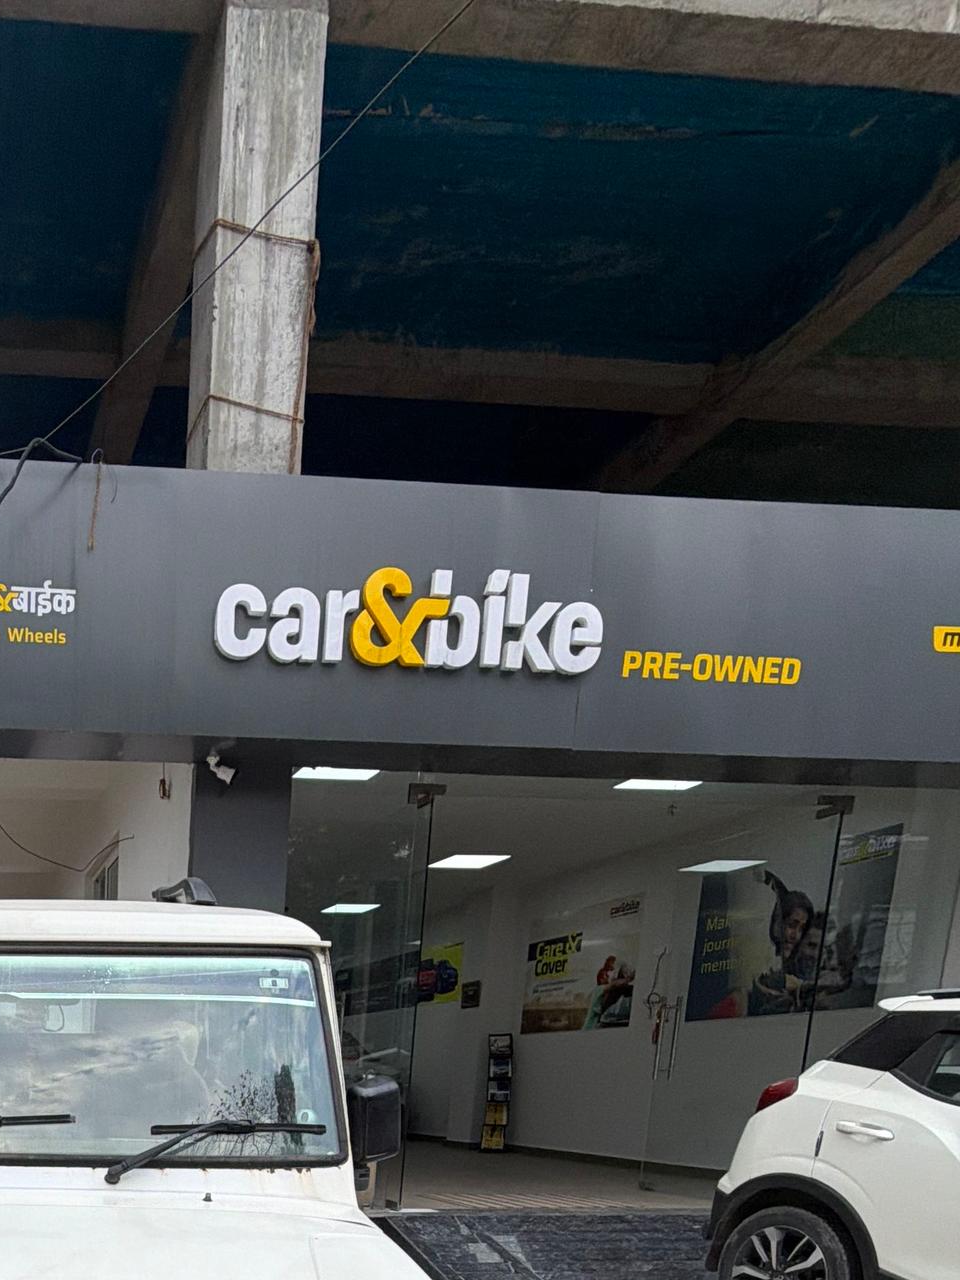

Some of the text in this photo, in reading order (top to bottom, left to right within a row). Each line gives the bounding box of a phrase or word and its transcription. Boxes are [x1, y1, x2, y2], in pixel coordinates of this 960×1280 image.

[213, 566, 604, 677] car&bike
[7, 627, 67, 645] Wheels
[621, 650, 802, 686] PRE-OWNED
[535, 940, 565, 959] Care
[534, 957, 568, 977] Cover
